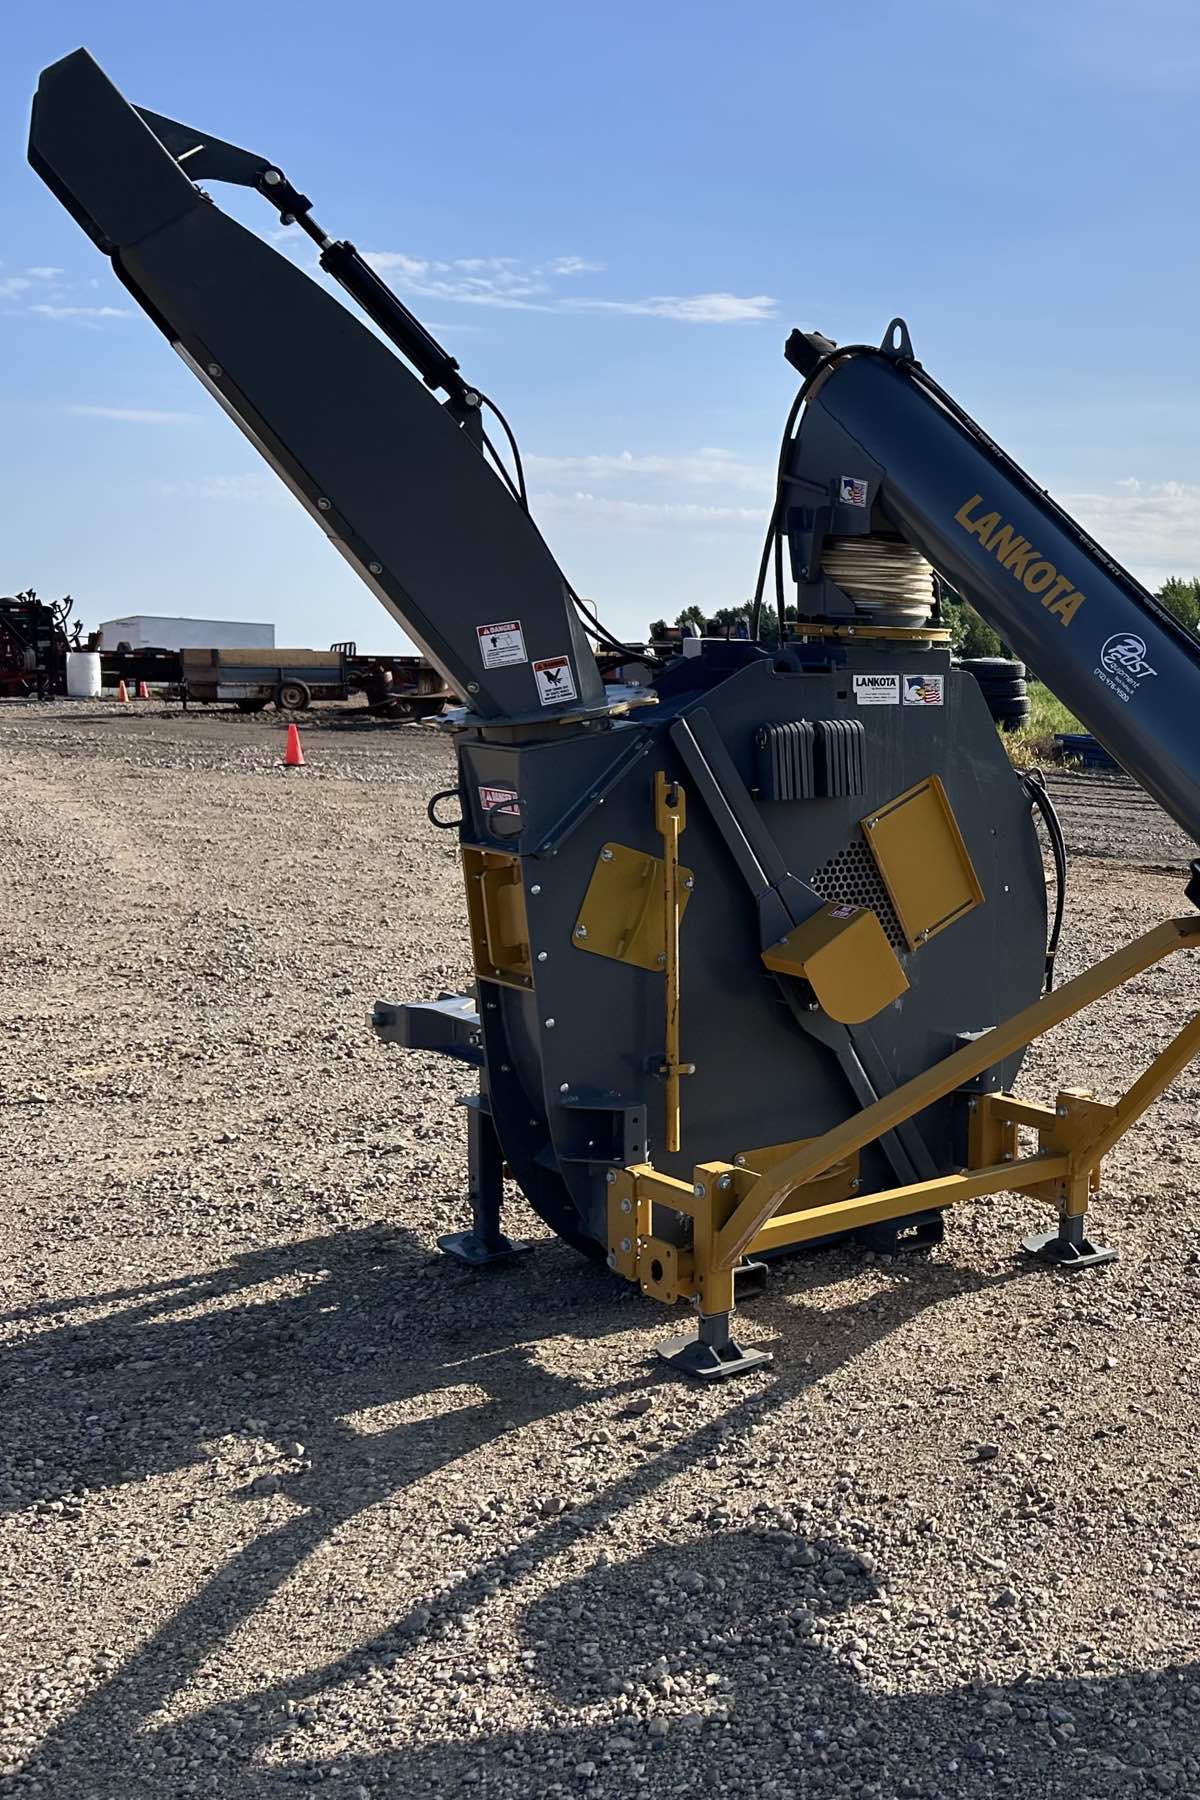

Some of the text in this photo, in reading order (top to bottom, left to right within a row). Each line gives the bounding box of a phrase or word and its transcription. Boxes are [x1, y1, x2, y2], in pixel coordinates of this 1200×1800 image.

[954, 494, 1087, 627] LANKOTA
[490, 623, 516, 634] DANGER
[1103, 652, 1140, 688] Equipment
[1108, 638, 1158, 678] POST
[856, 677, 896, 687] LANKOTA
